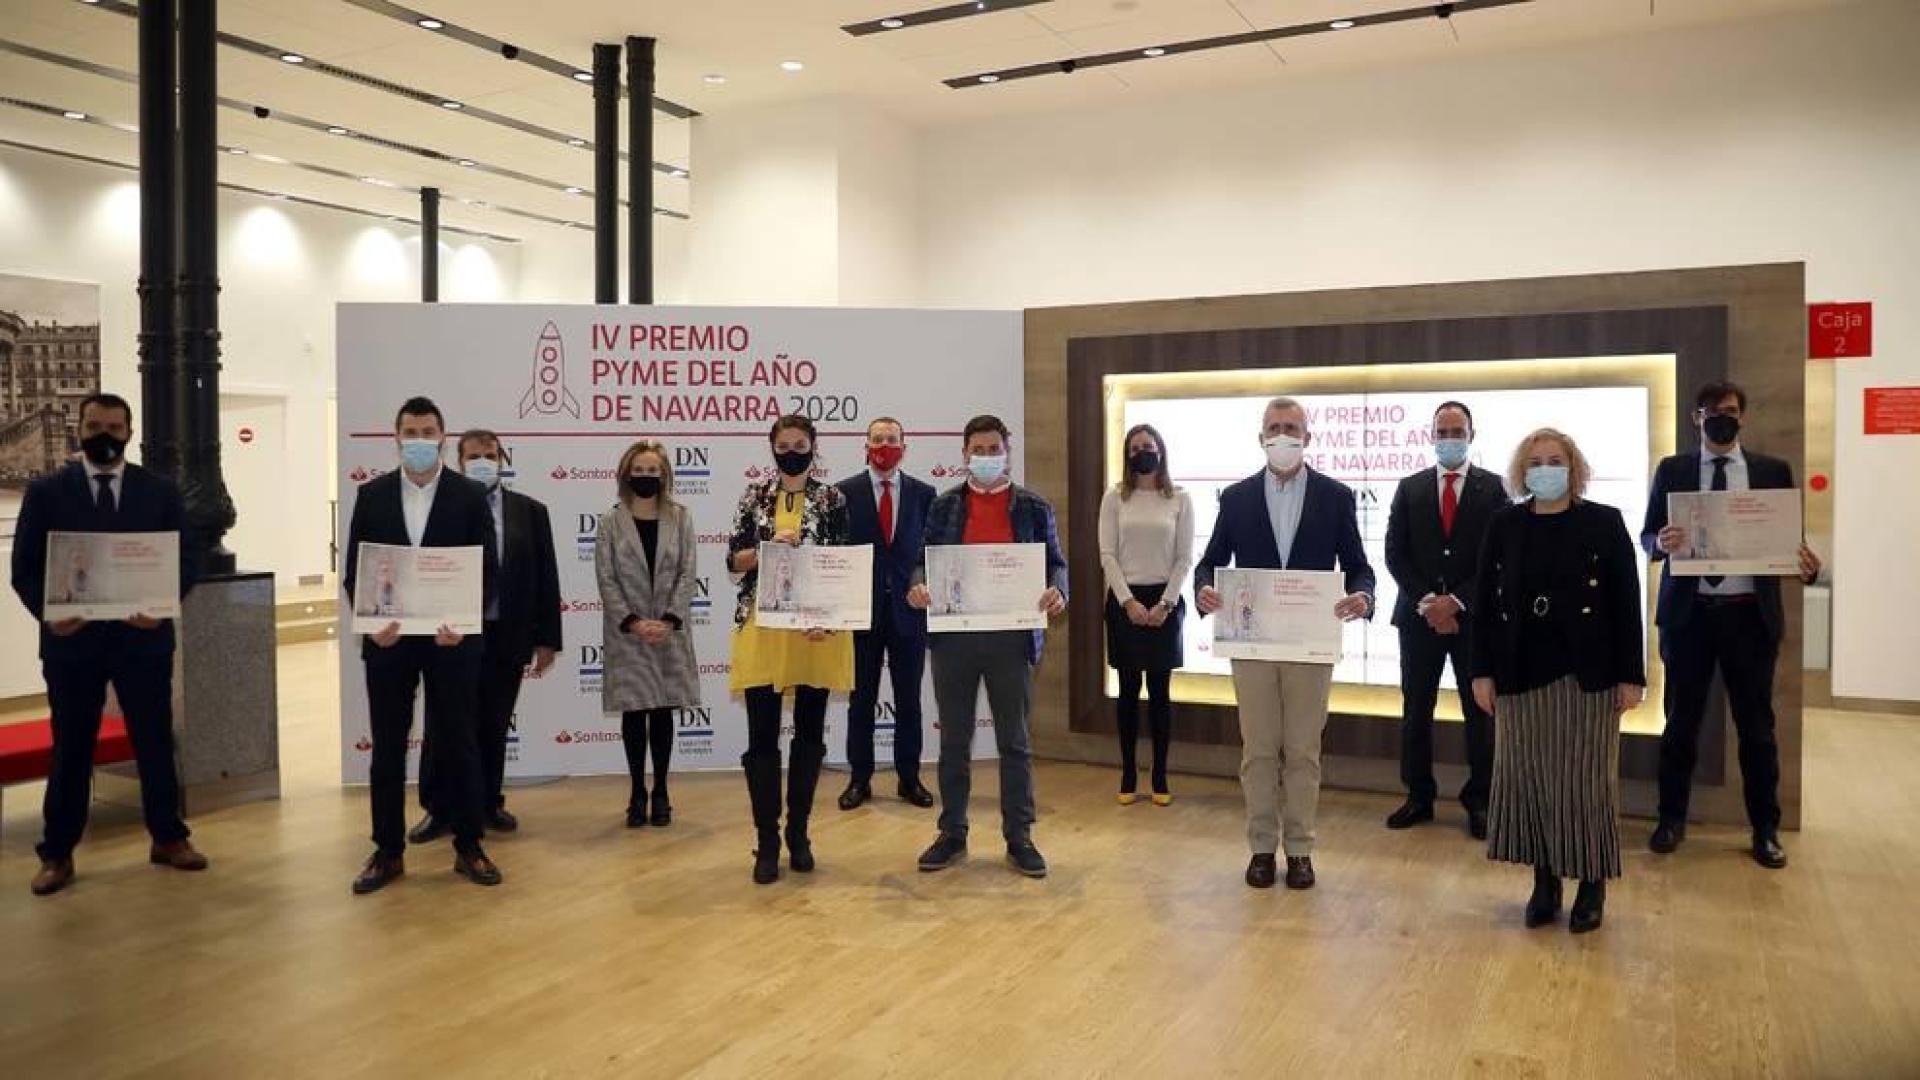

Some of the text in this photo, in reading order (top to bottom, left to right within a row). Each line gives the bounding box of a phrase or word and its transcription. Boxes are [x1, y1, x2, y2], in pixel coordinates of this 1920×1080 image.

[1819, 311, 1862, 332] Caja
[592, 324, 749, 351] IV PREMIO
[1834, 337, 1846, 354] 2
[592, 354, 818, 387] PYME DEL AÑO
[592, 395, 858, 421] DE NAVARRA 2020
[1325, 405, 1405, 424] PREMIO
[1311, 424, 1437, 448] YME DEL AÑ
[675, 447, 709, 466] DN
[1333, 453, 1427, 471] NAVARRA
[679, 707, 711, 727] DN
